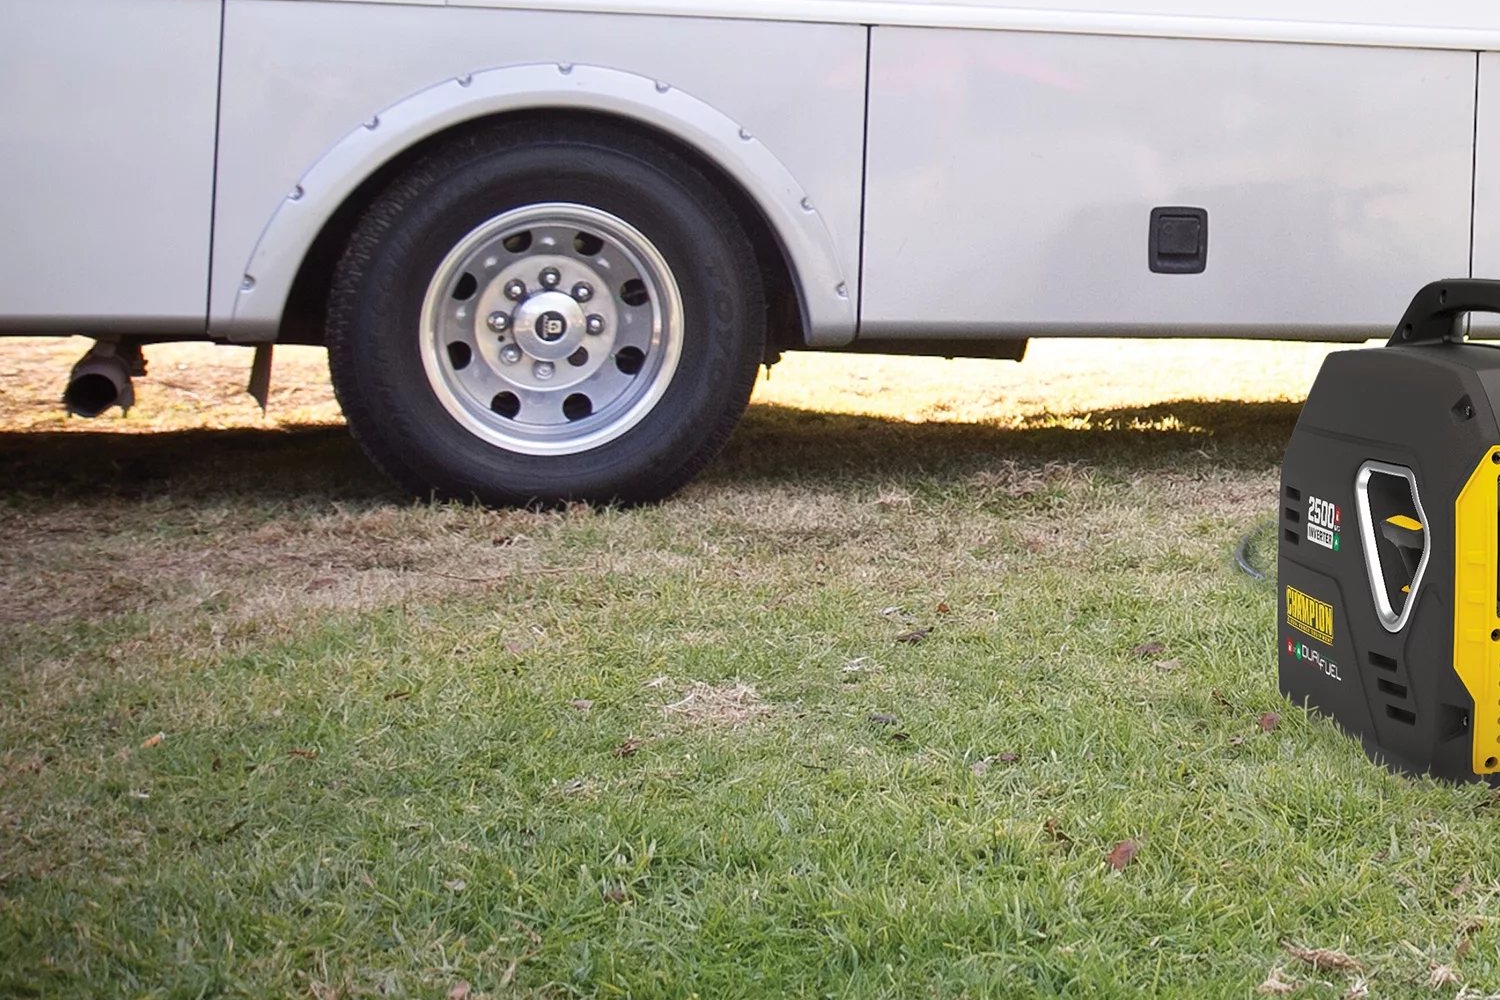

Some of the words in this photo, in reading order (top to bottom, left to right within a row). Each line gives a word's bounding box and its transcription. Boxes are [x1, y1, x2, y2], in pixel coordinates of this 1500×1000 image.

[1308, 495, 1335, 530] 2500
[1308, 525, 1333, 546] INVERTER
[1287, 586, 1334, 638] CHAMPION
